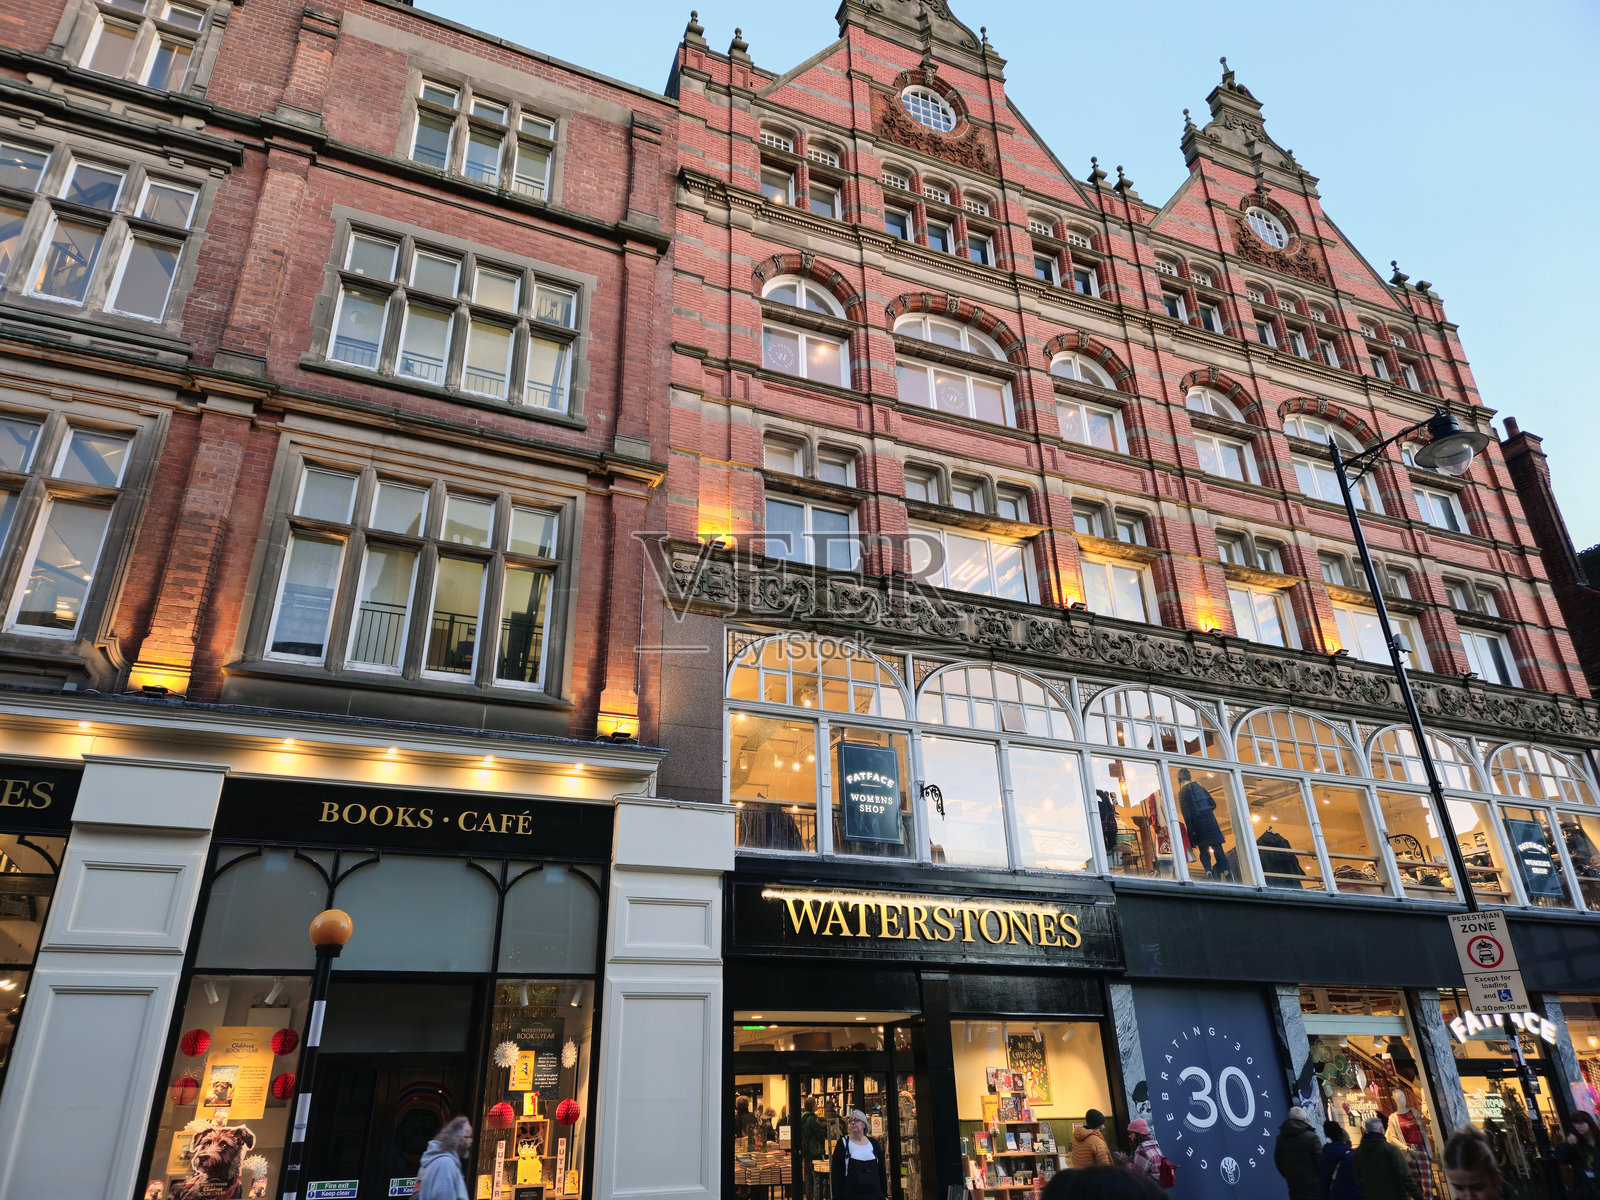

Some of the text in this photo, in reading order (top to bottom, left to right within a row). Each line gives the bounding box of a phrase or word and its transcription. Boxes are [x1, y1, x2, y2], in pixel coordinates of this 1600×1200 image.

[0, 778, 55, 810] ES
[846, 771, 895, 788] FATFACE
[850, 793, 893, 805] WOMENS
[859, 804, 885, 814] SHOP
[318, 801, 533, 835] BOOKS CAFÉ
[782, 897, 1083, 949] WATERSTONES
[1452, 912, 1500, 922] PEDESTRIAN
[1461, 922, 1497, 933] ZONE
[1161, 1026, 1216, 1170] CELEBRATING
[1249, 1090, 1272, 1168] YEARS
[1178, 1066, 1256, 1131] 30
[494, 1143, 504, 1197] BUTTER
[557, 1140, 565, 1193] BUTTER
